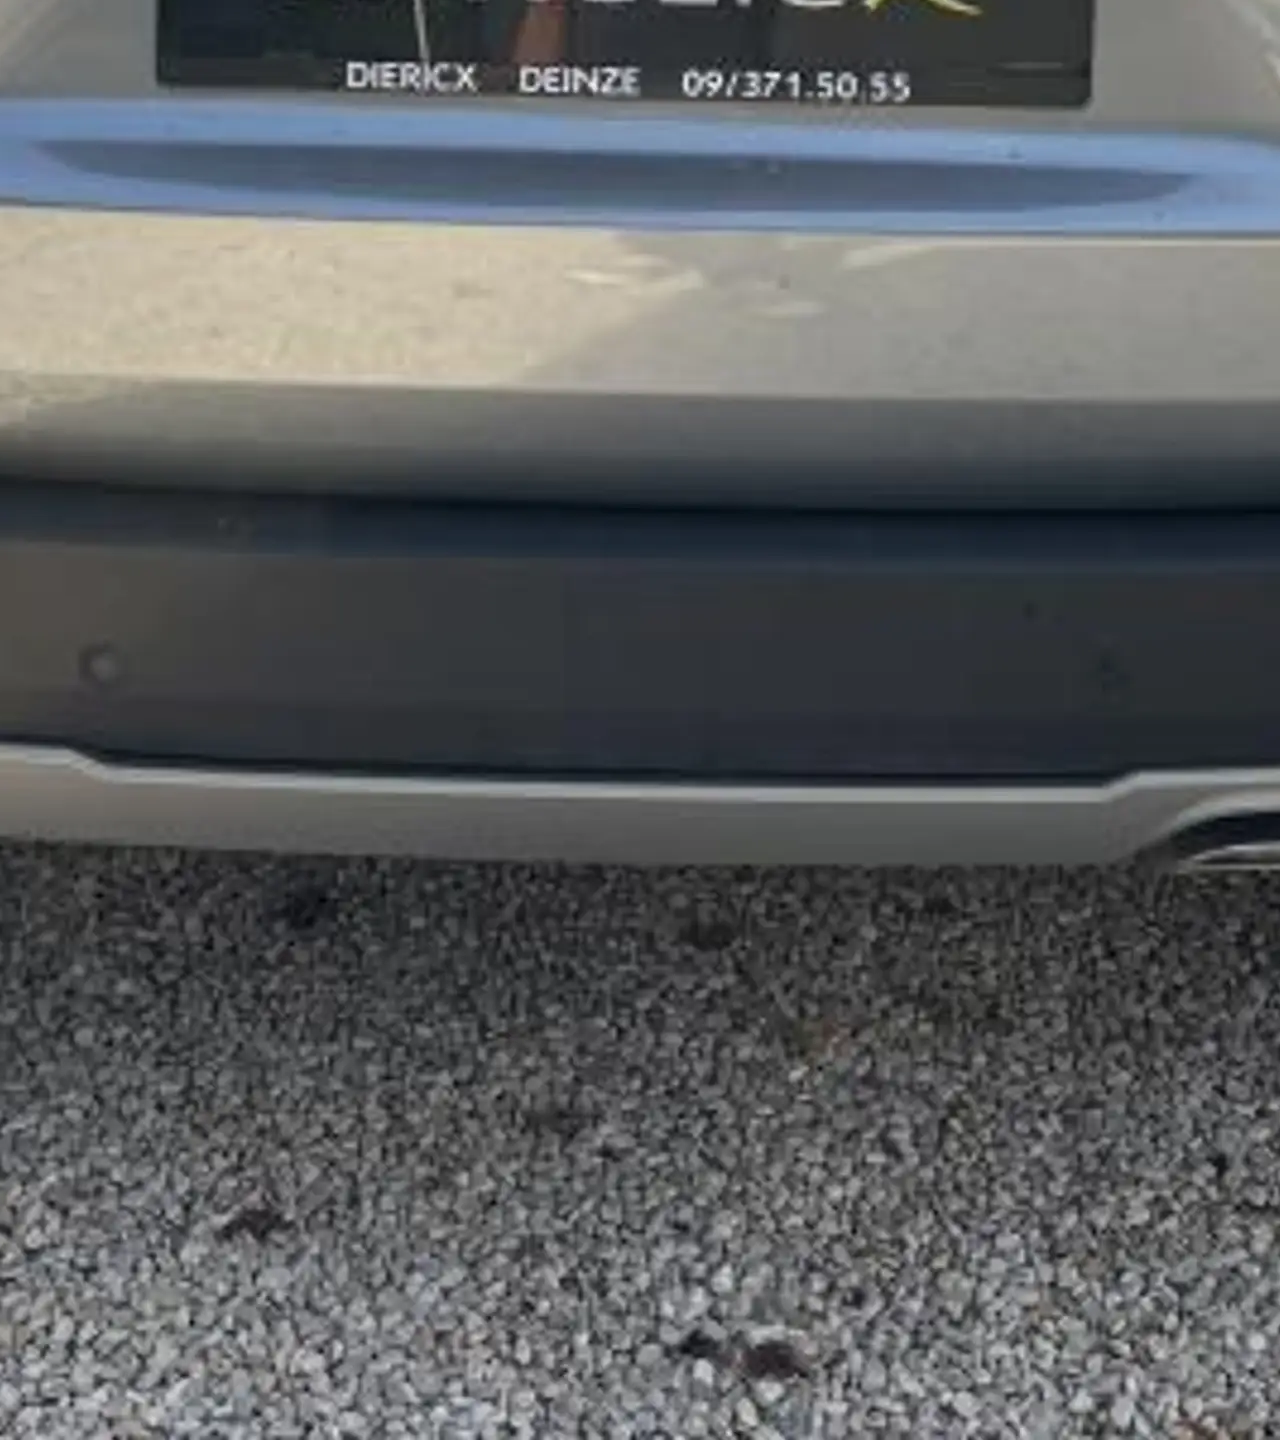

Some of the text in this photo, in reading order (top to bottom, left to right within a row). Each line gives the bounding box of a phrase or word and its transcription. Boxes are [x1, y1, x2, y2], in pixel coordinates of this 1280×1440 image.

[345, 60, 911, 105] DIERICX DEINZE 09/371.50.55
